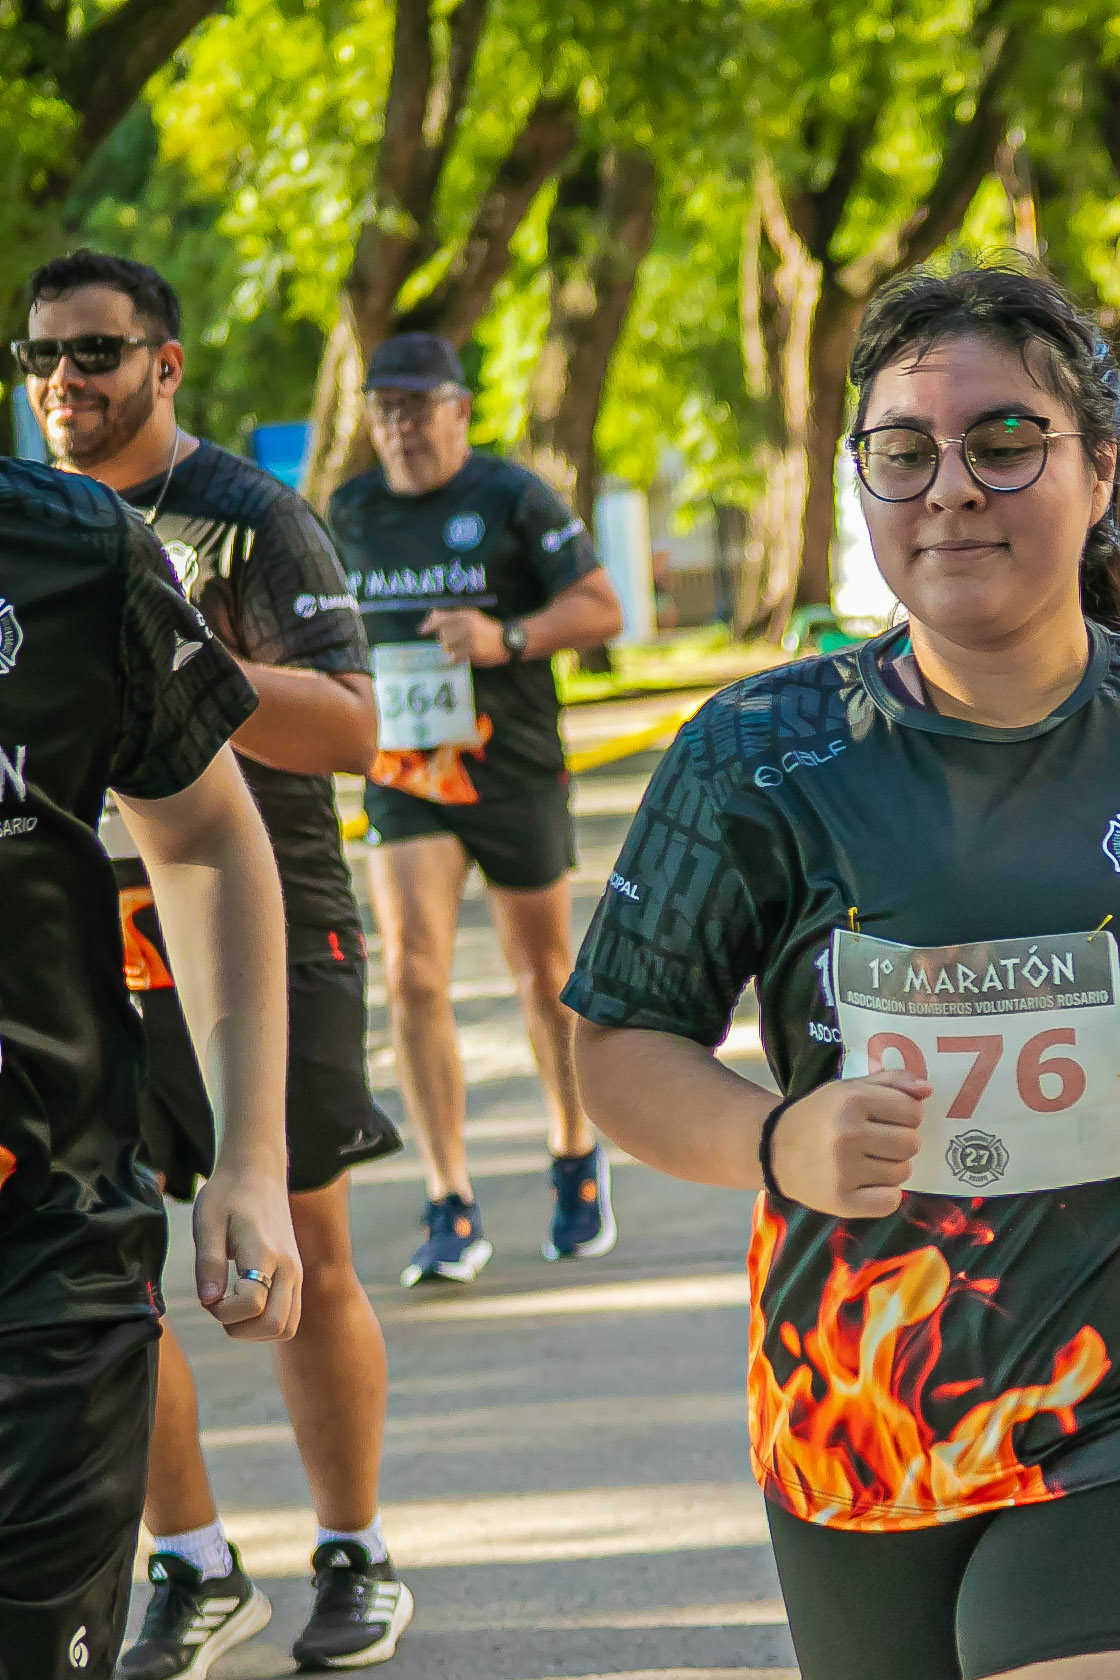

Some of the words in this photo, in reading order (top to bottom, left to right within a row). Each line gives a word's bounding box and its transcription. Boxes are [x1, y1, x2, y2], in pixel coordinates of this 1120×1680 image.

[903, 944, 1075, 995] MARATÓN
[909, 1002, 972, 1015] BOMBEROS
[974, 995, 1055, 1014] VOLUNTARIOS
[1056, 989, 1109, 1007] ROSARIO
[965, 1147, 989, 1167] 27
